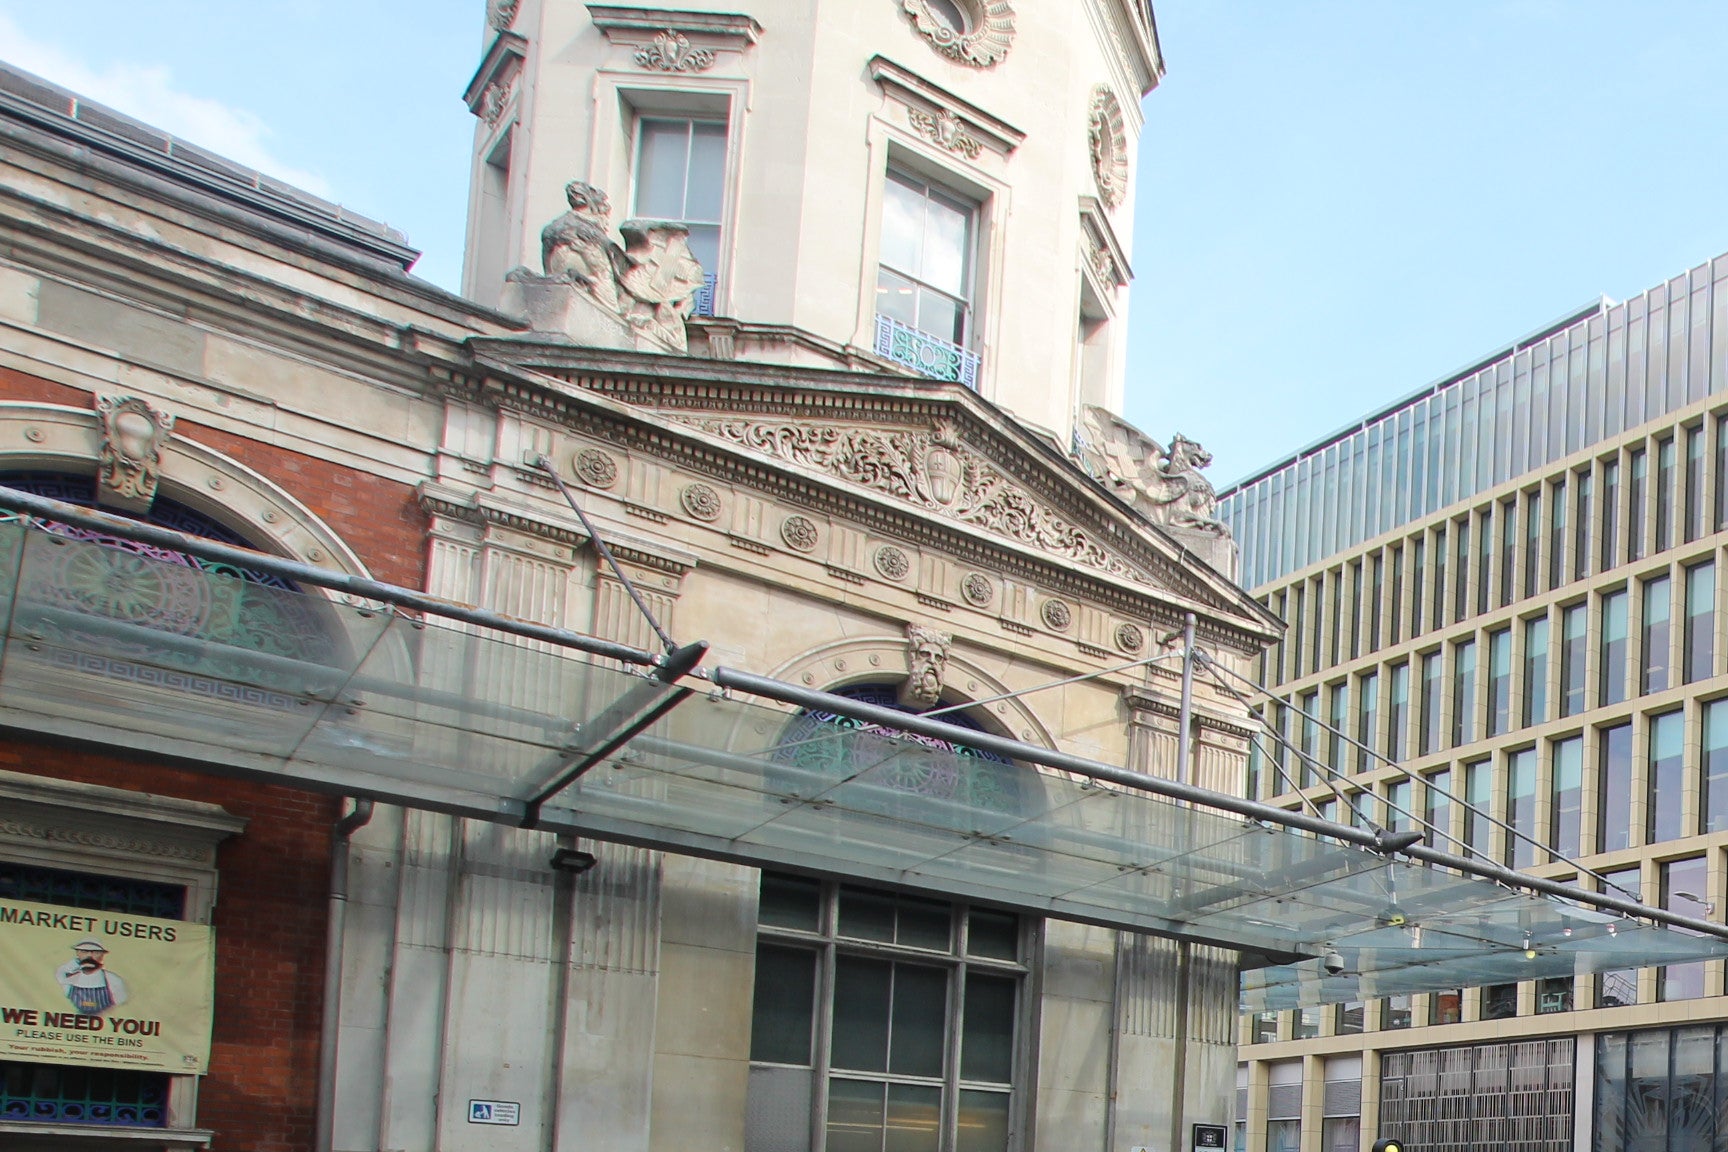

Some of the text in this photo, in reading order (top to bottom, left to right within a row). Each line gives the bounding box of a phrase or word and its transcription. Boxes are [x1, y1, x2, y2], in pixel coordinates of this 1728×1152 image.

[1, 907, 177, 942] MARKET USERS
[2, 1007, 161, 1036] WE NEED YOU!
[17, 1029, 143, 1048] PLEASE USE THE BINS
